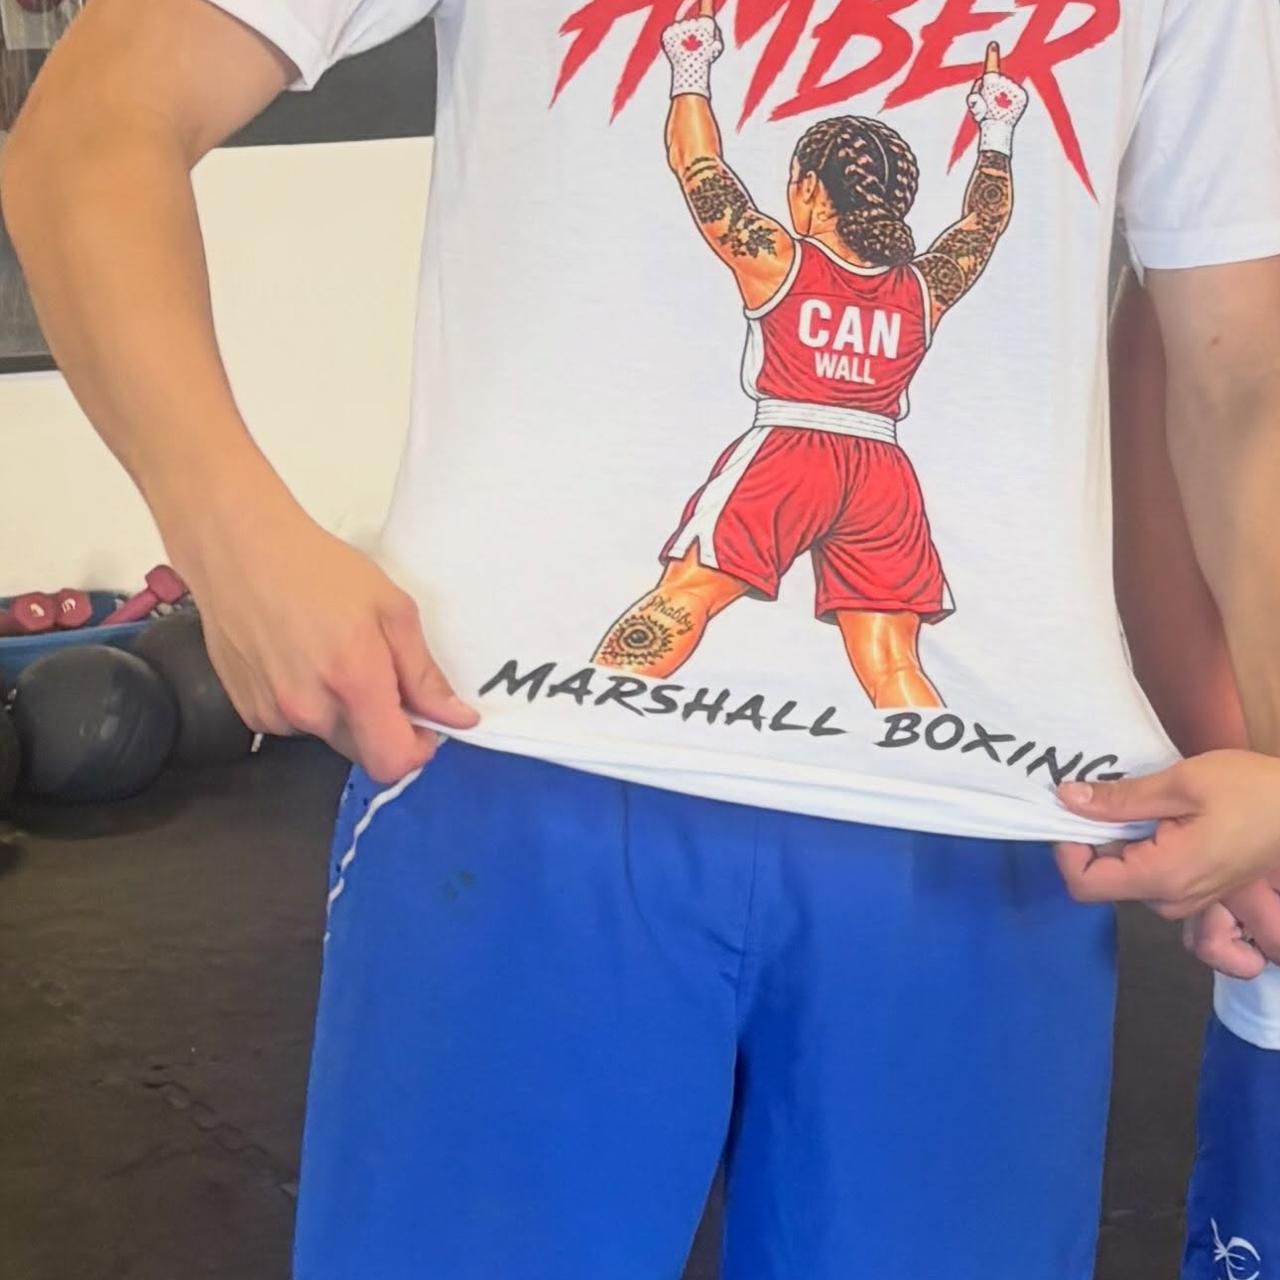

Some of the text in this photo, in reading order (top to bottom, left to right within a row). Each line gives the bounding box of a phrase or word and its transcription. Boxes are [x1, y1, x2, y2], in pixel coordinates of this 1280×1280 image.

[797, 297, 902, 360] CAN
[814, 350, 877, 385] WALL
[478, 659, 1129, 787] MARSHALL BOXING
